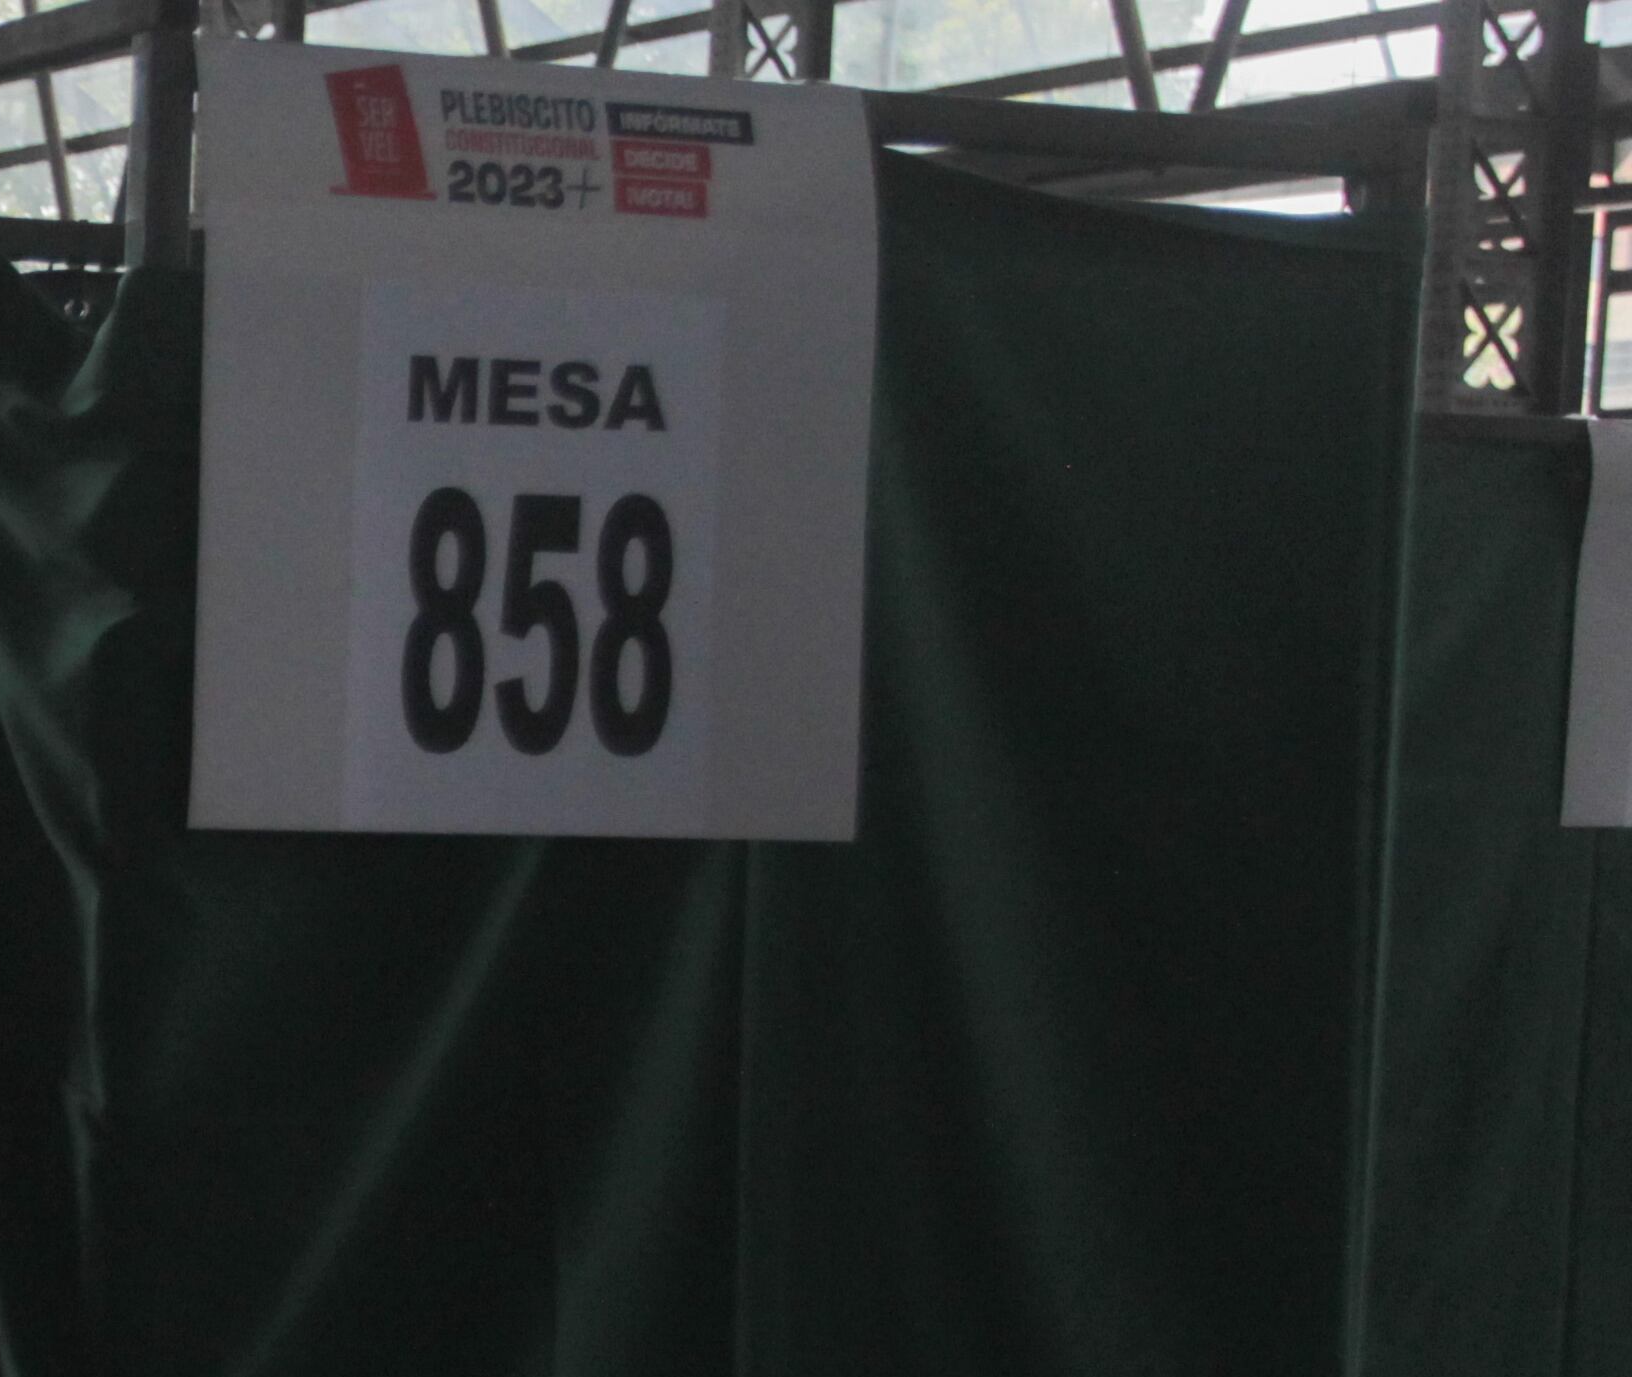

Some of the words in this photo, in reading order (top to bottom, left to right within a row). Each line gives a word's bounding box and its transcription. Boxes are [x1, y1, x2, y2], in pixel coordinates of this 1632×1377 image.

[356, 96, 398, 128] SER
[441, 89, 597, 133] PLEBISCITO
[360, 130, 400, 162] VEL
[624, 150, 698, 172] DECIDE
[407, 355, 667, 431] MESA
[401, 486, 673, 757] 858
